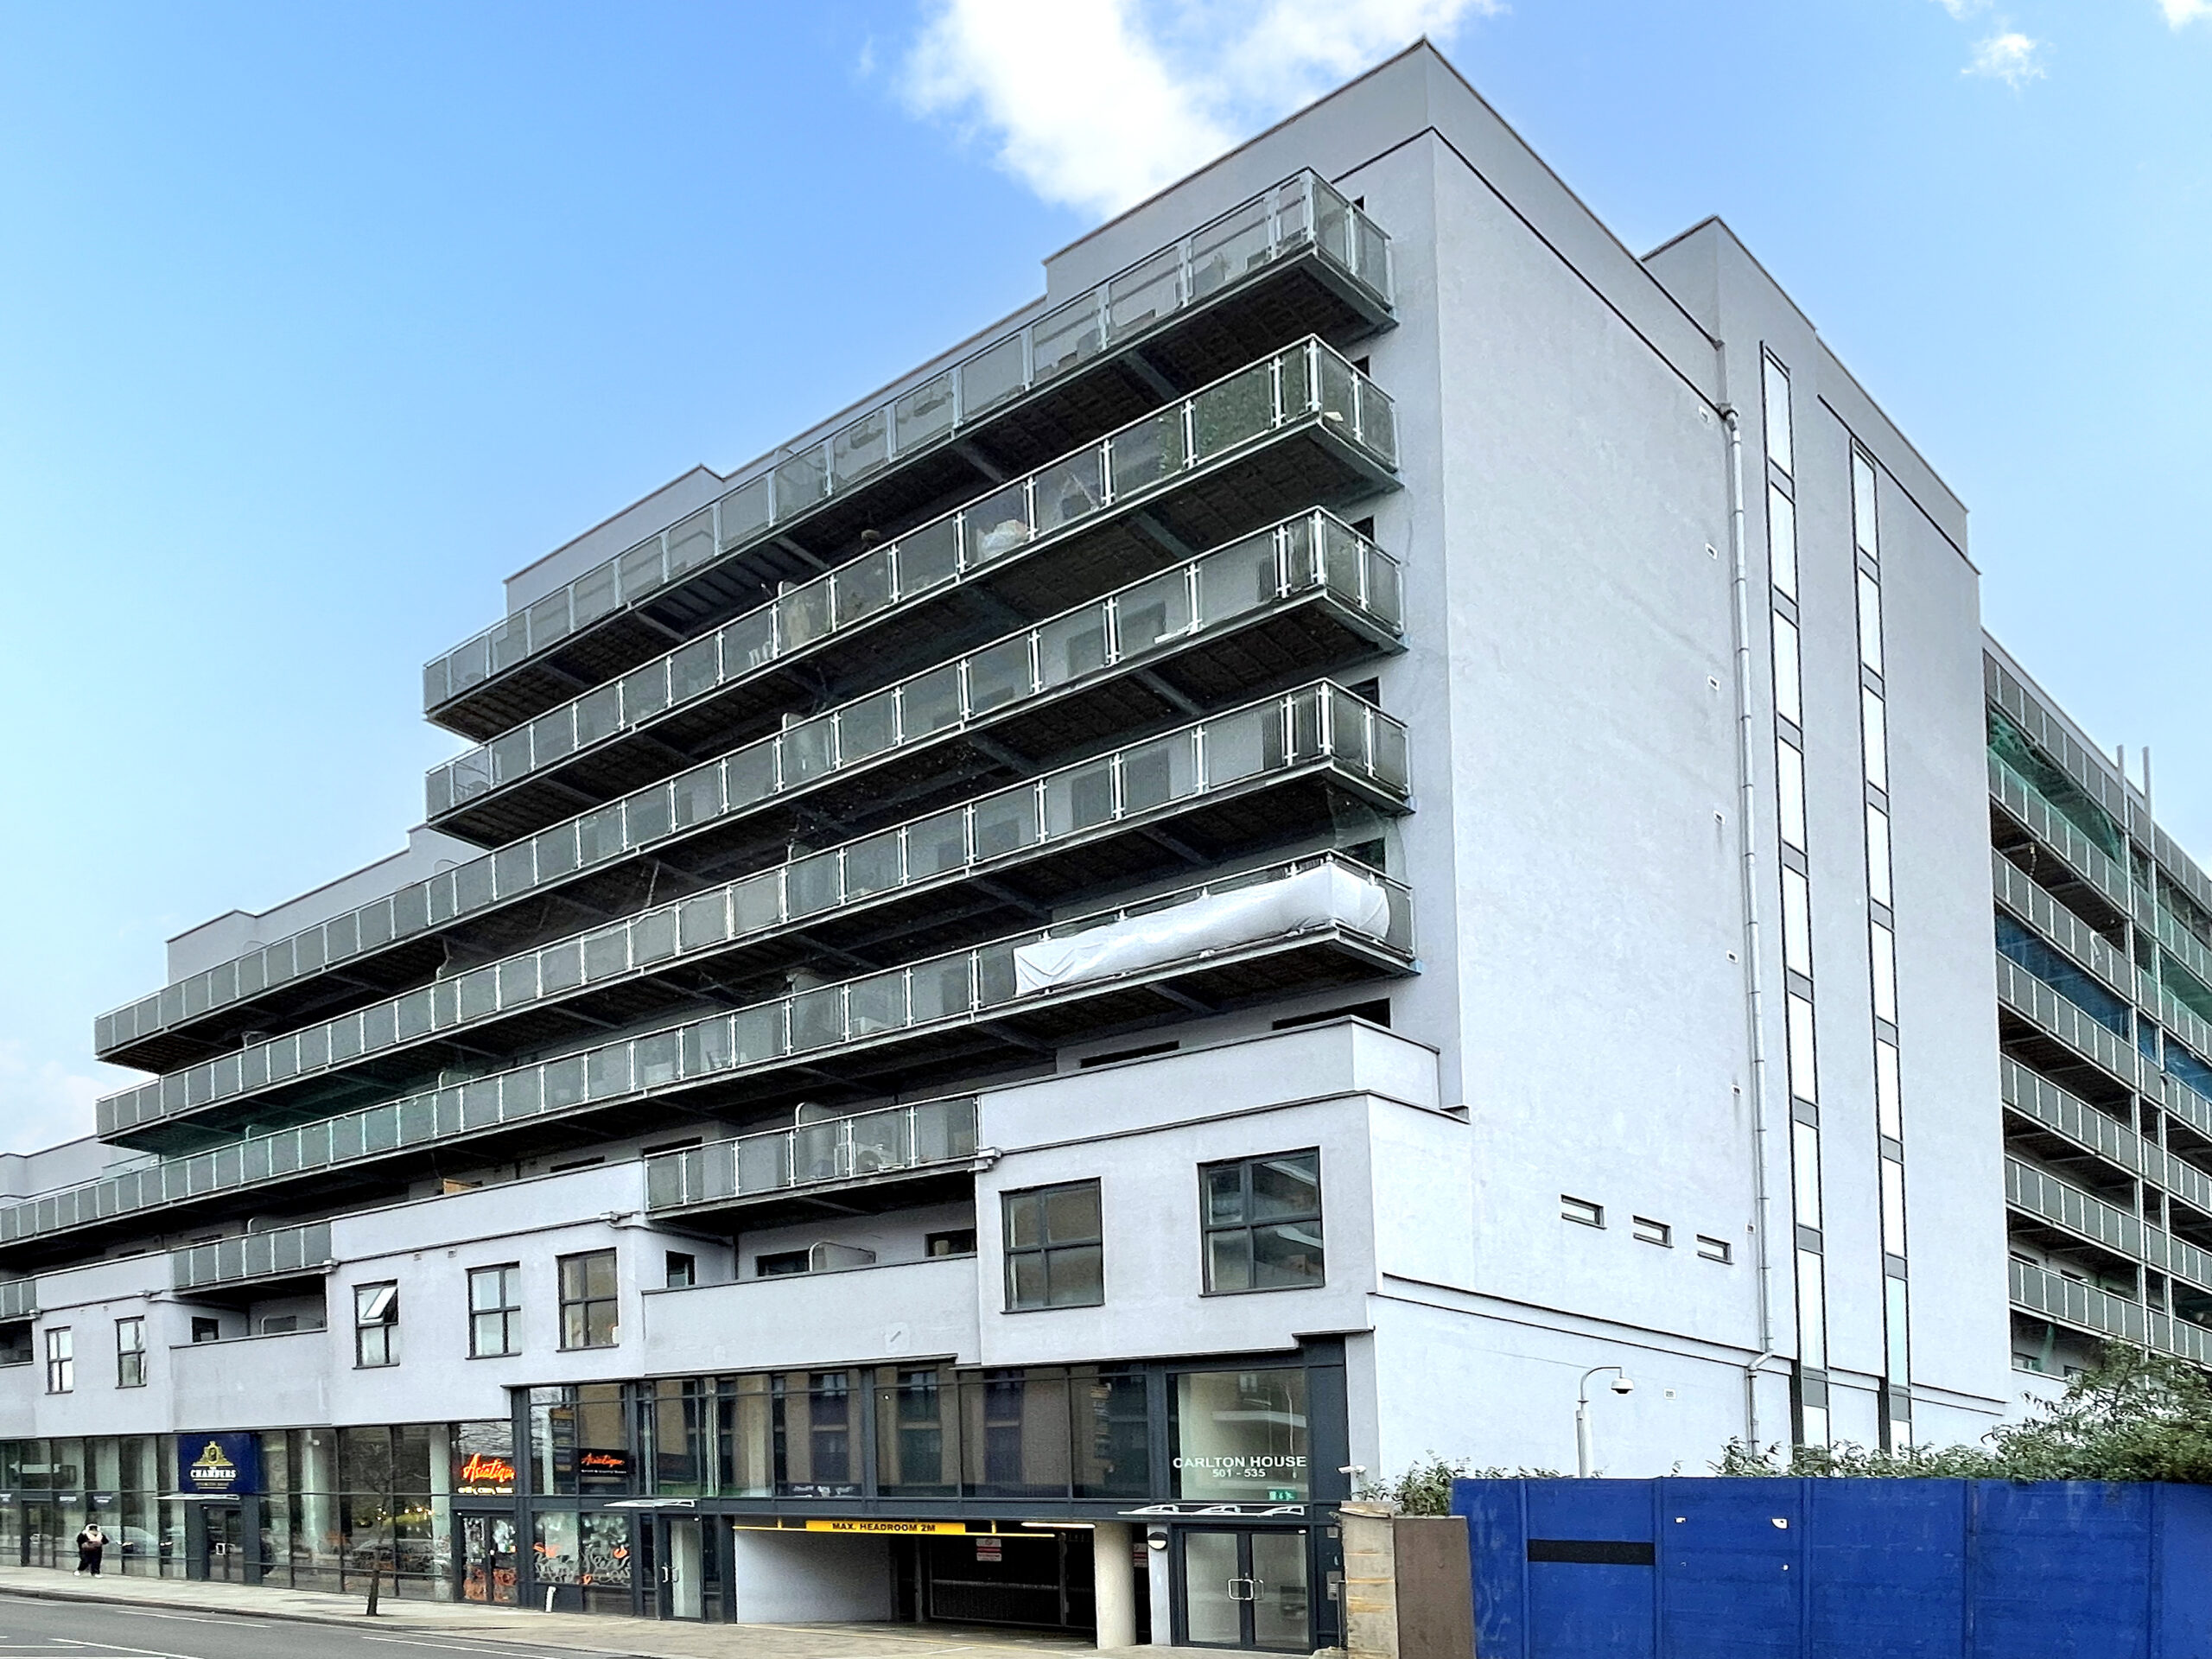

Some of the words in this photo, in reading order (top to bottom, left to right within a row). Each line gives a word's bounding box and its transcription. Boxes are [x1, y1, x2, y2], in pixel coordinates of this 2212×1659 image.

[1173, 1457, 1246, 1468] CARLTON
[1250, 1456, 1306, 1467] HOUSE
[190, 1470, 237, 1478] CHAMBERS
[1212, 1469, 1231, 1478] 501
[1244, 1469, 1266, 1478] 535
